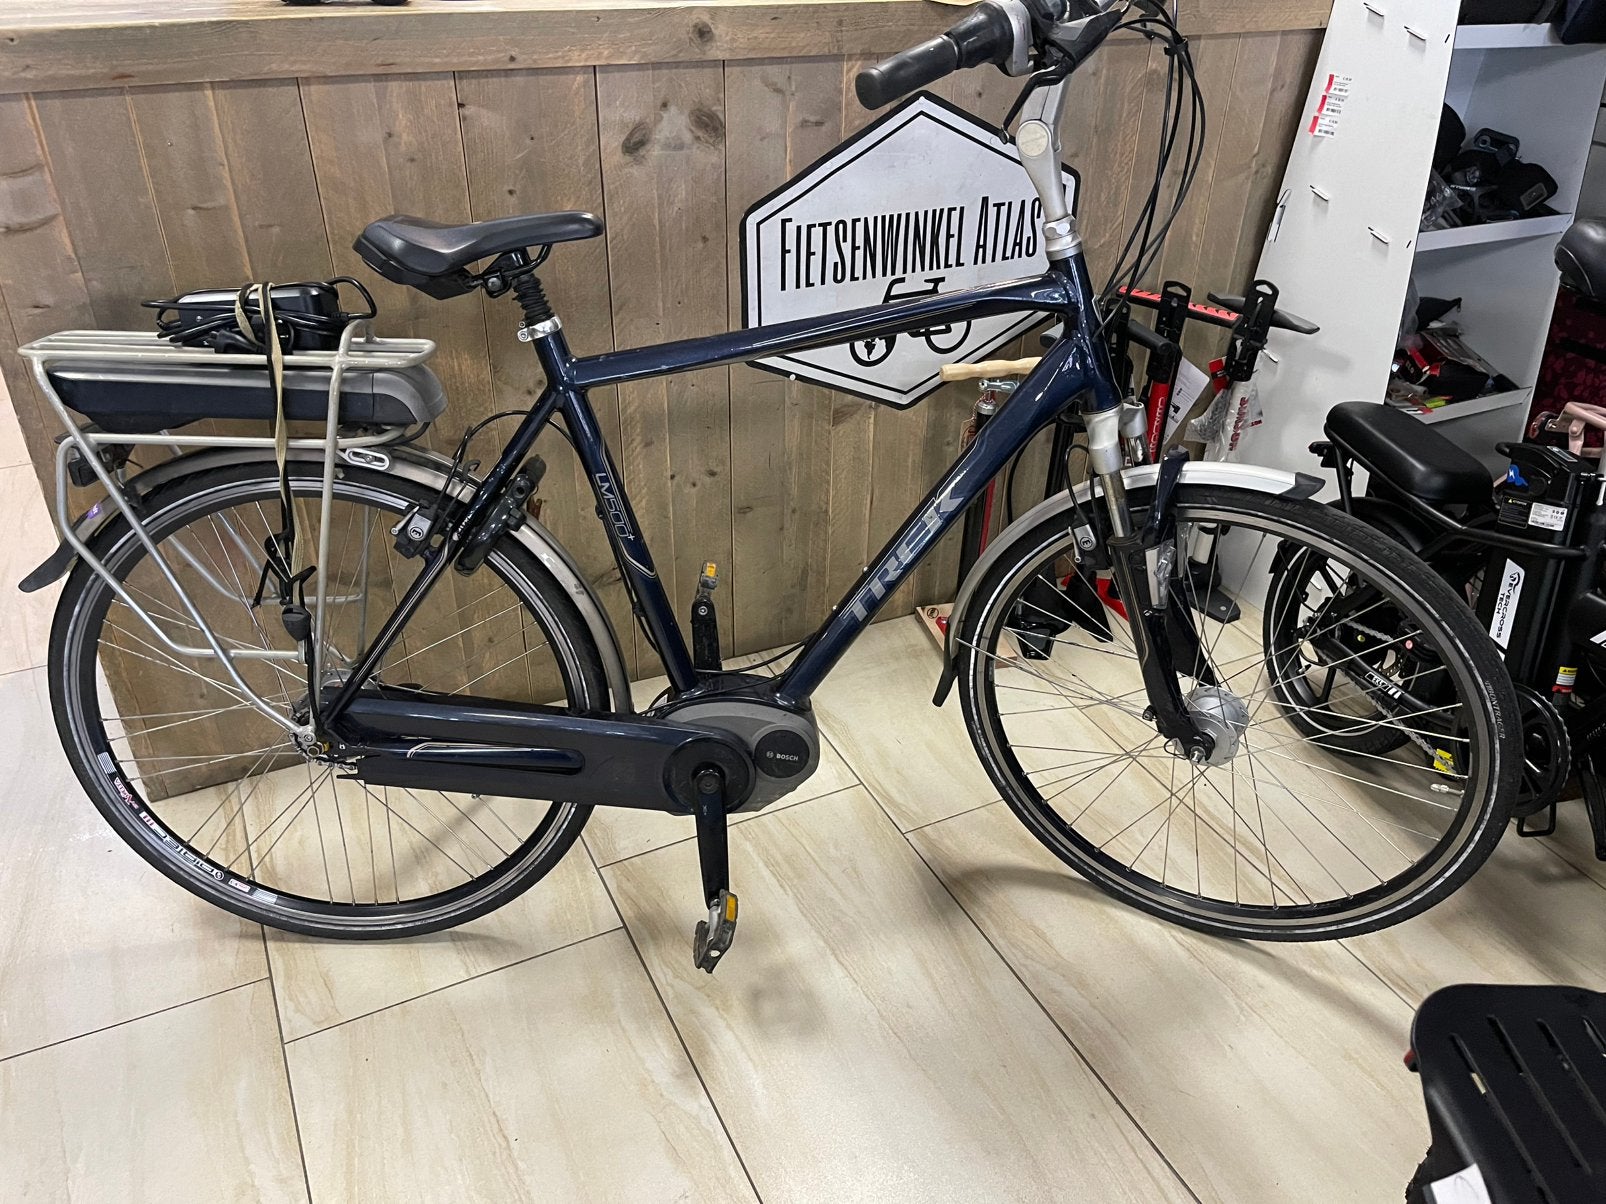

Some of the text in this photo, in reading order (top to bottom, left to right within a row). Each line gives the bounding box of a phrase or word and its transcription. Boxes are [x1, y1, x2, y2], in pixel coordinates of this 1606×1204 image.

[780, 195, 1043, 291] FIETSENWINKEL ATLAS
[841, 484, 965, 622] TREK
[1496, 592, 1506, 615] TECH
[1496, 582, 1515, 638] EVERCROSS
[776, 753, 799, 761] BOSCH
